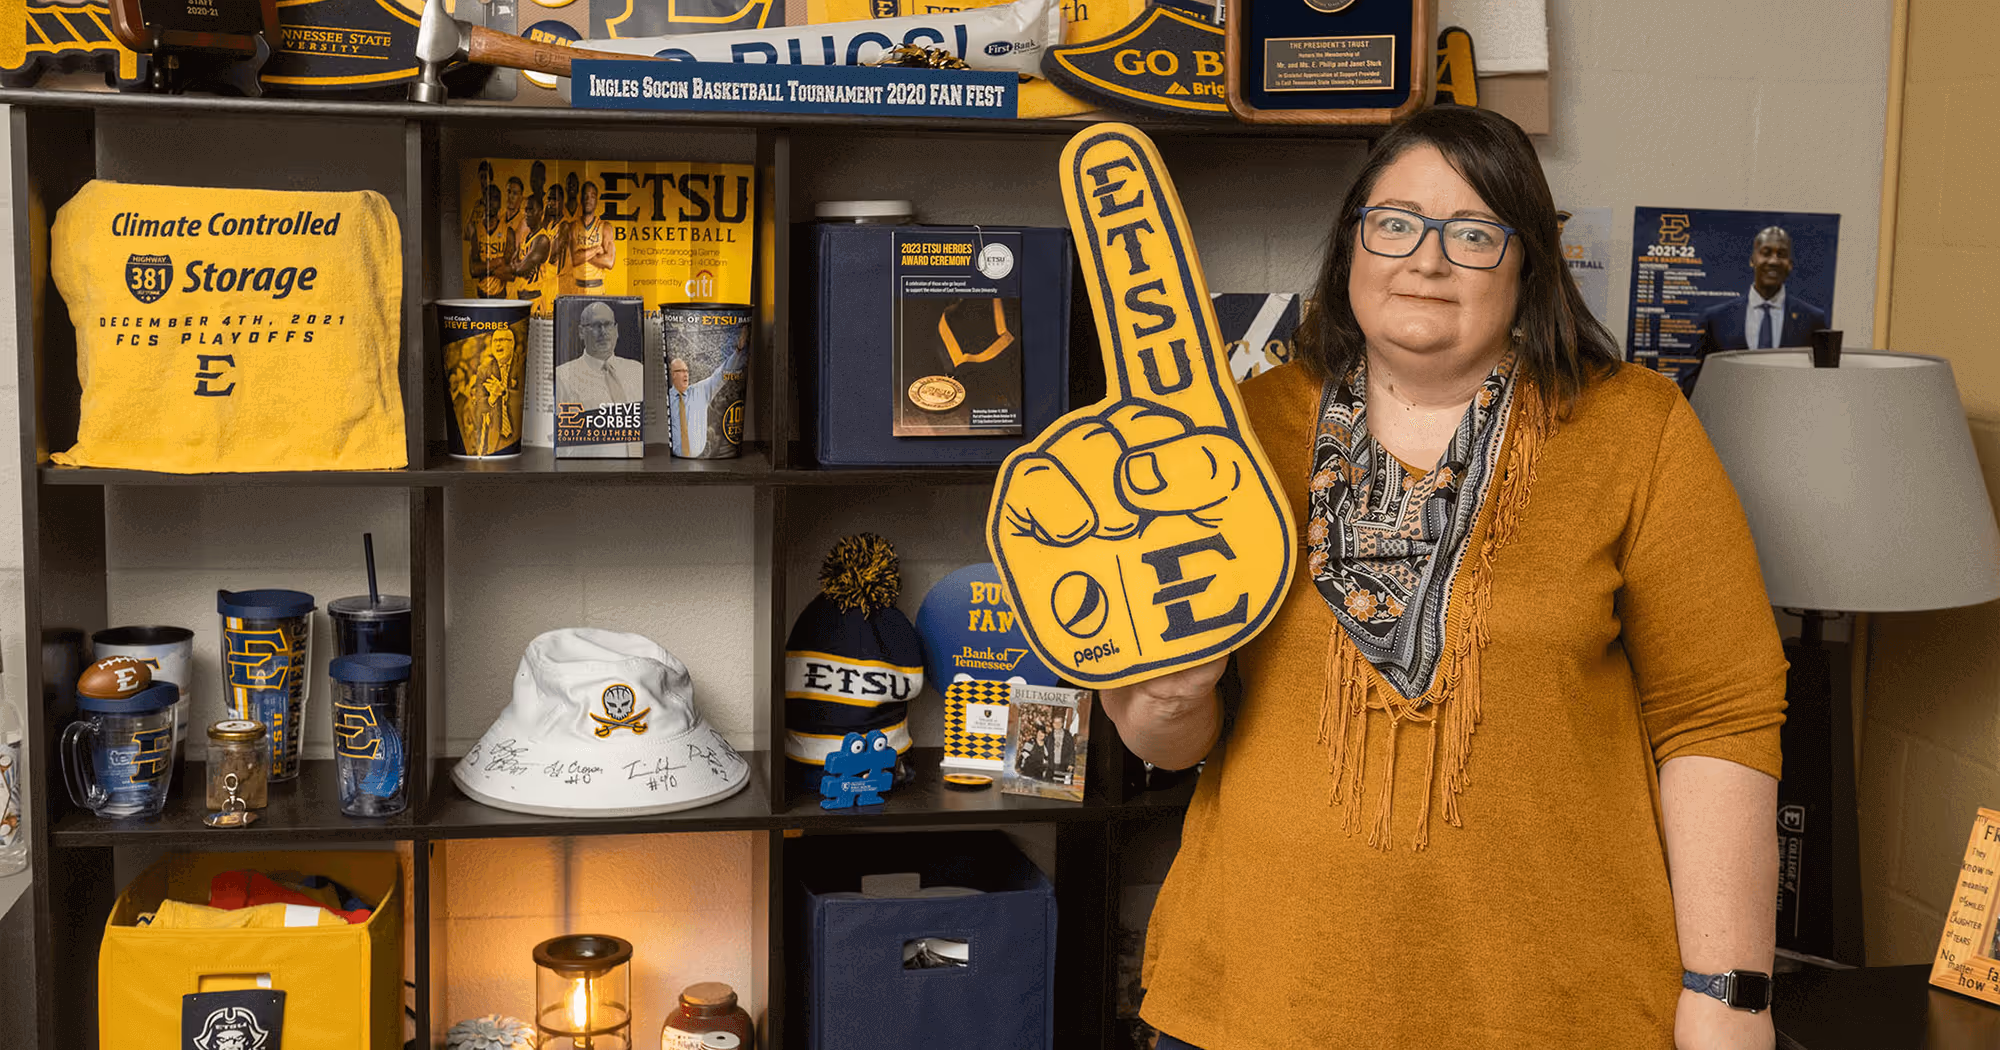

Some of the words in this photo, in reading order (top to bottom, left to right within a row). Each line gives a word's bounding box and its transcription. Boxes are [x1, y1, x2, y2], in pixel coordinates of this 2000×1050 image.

[187, 6, 219, 16] 2020-21
[281, 28, 344, 43] NNESSEE
[349, 33, 392, 47] STATE
[1303, 41, 1346, 49] PRESIDENT'S
[1347, 40, 1370, 48] TRUST
[287, 40, 361, 54] VERSITY
[987, 46, 1011, 55] First
[1014, 40, 1035, 51] Bank
[1113, 48, 1180, 77] GO
[1192, 50, 1225, 77] B
[589, 74, 639, 98] INGLES
[642, 76, 689, 99] SOCON
[692, 77, 785, 102] BASKETBALL
[788, 80, 884, 105] TOURNAMENT
[887, 83, 927, 106] 2020
[929, 84, 963, 107] FAN
[966, 85, 1005, 107] FEST
[600, 172, 750, 225] ETSU
[112, 212, 204, 237] Climate
[208, 211, 341, 237] Controlled
[614, 226, 737, 243] BASKETBALL
[901, 243, 921, 254] 2023
[922, 243, 942, 254] ETSU
[942, 243, 973, 254] HEROES
[1646, 244, 1696, 258] 2021-22
[132, 255, 168, 264] HIGHWAY
[901, 255, 929, 266] AWARD
[930, 255, 971, 266] CEREMONY
[1566, 260, 1605, 270] ETBALL
[131, 267, 167, 291] 381
[182, 260, 318, 300] Storage
[1085, 155, 1198, 398] ETSU
[100, 315, 209, 329] DECEMBER
[221, 314, 275, 329] 4TH,
[291, 313, 346, 326] 2021
[444, 320, 468, 330] STEVE
[470, 321, 509, 331] FORBES
[702, 315, 738, 326] ETSU
[116, 333, 160, 347] FCS
[180, 330, 315, 345] PLAYOFFS
[193, 354, 237, 397] E
[598, 402, 641, 415] STEVE
[586, 415, 641, 428] FORBES
[557, 429, 582, 437] 2017
[586, 429, 641, 437] SOUTHERN
[1142, 531, 1250, 645] E
[968, 608, 1015, 633] FAN
[224, 628, 290, 691] E
[962, 646, 995, 660] Bank
[996, 648, 1009, 661] of
[952, 654, 1013, 671] Tennessee
[114, 666, 140, 692] E
[803, 662, 913, 701] ETSU
[1015, 688, 1069, 704] BILTMORE
[272, 712, 284, 777] ETSU
[1972, 847, 1987, 860] They
[1961, 860, 1984, 876] know
[1961, 880, 1989, 895] meaning
[1964, 900, 1986, 912] SMILES
[1950, 915, 1983, 930] LAUGHTER
[1952, 933, 1972, 946] TEARS
[1940, 948, 1956, 963] No
[1947, 961, 1975, 976] matter
[1986, 966, 2000, 983] fa
[1958, 972, 1987, 992] how
